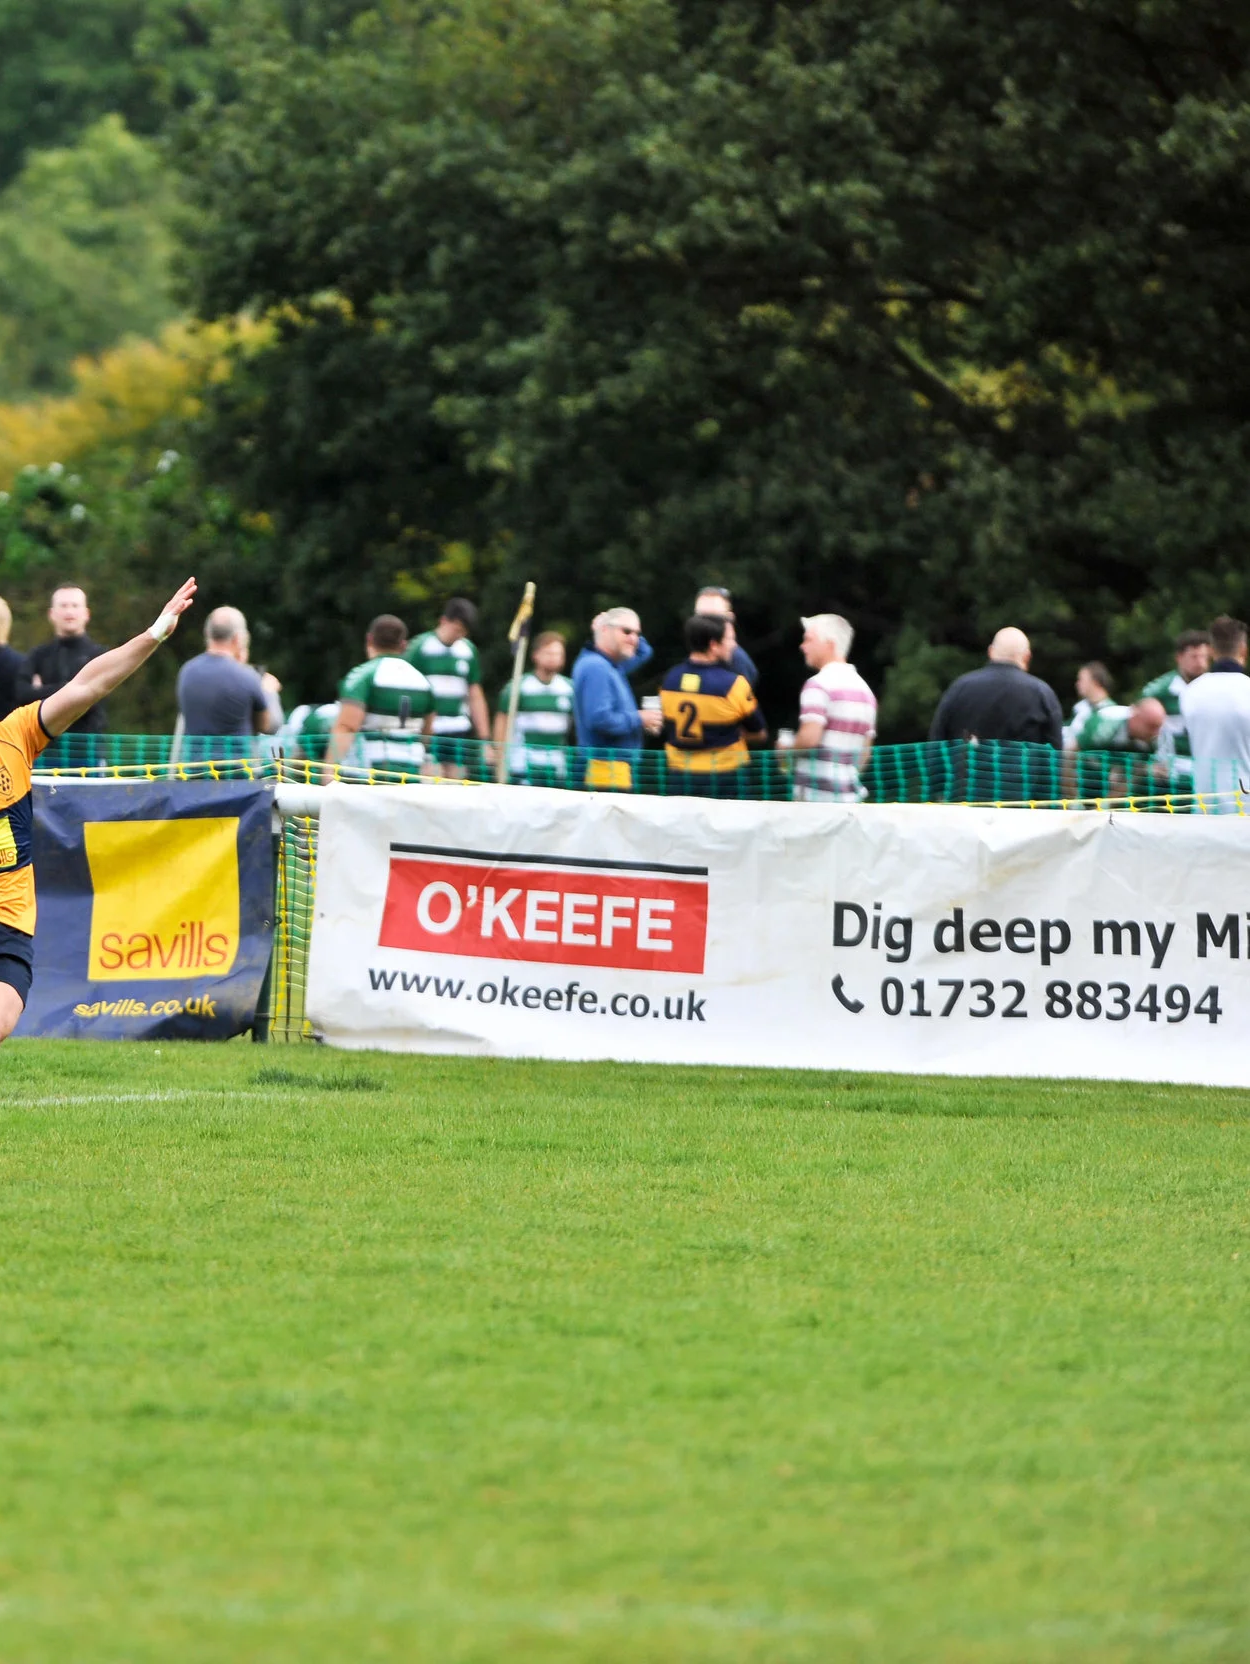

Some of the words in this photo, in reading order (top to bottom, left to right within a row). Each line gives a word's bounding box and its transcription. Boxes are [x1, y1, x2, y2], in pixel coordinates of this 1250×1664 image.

[678, 701, 700, 738] 2
[416, 881, 676, 952] O'KEEFE
[832, 901, 913, 963] Dig
[933, 907, 1071, 966] deep
[1093, 919, 1176, 969] my
[99, 921, 229, 969] savills
[72, 994, 217, 1018] savills.co.uk
[368, 968, 706, 1022] www.okeefe.co.uk
[880, 976, 1028, 1018] 01732
[1044, 980, 1223, 1024] 883494
